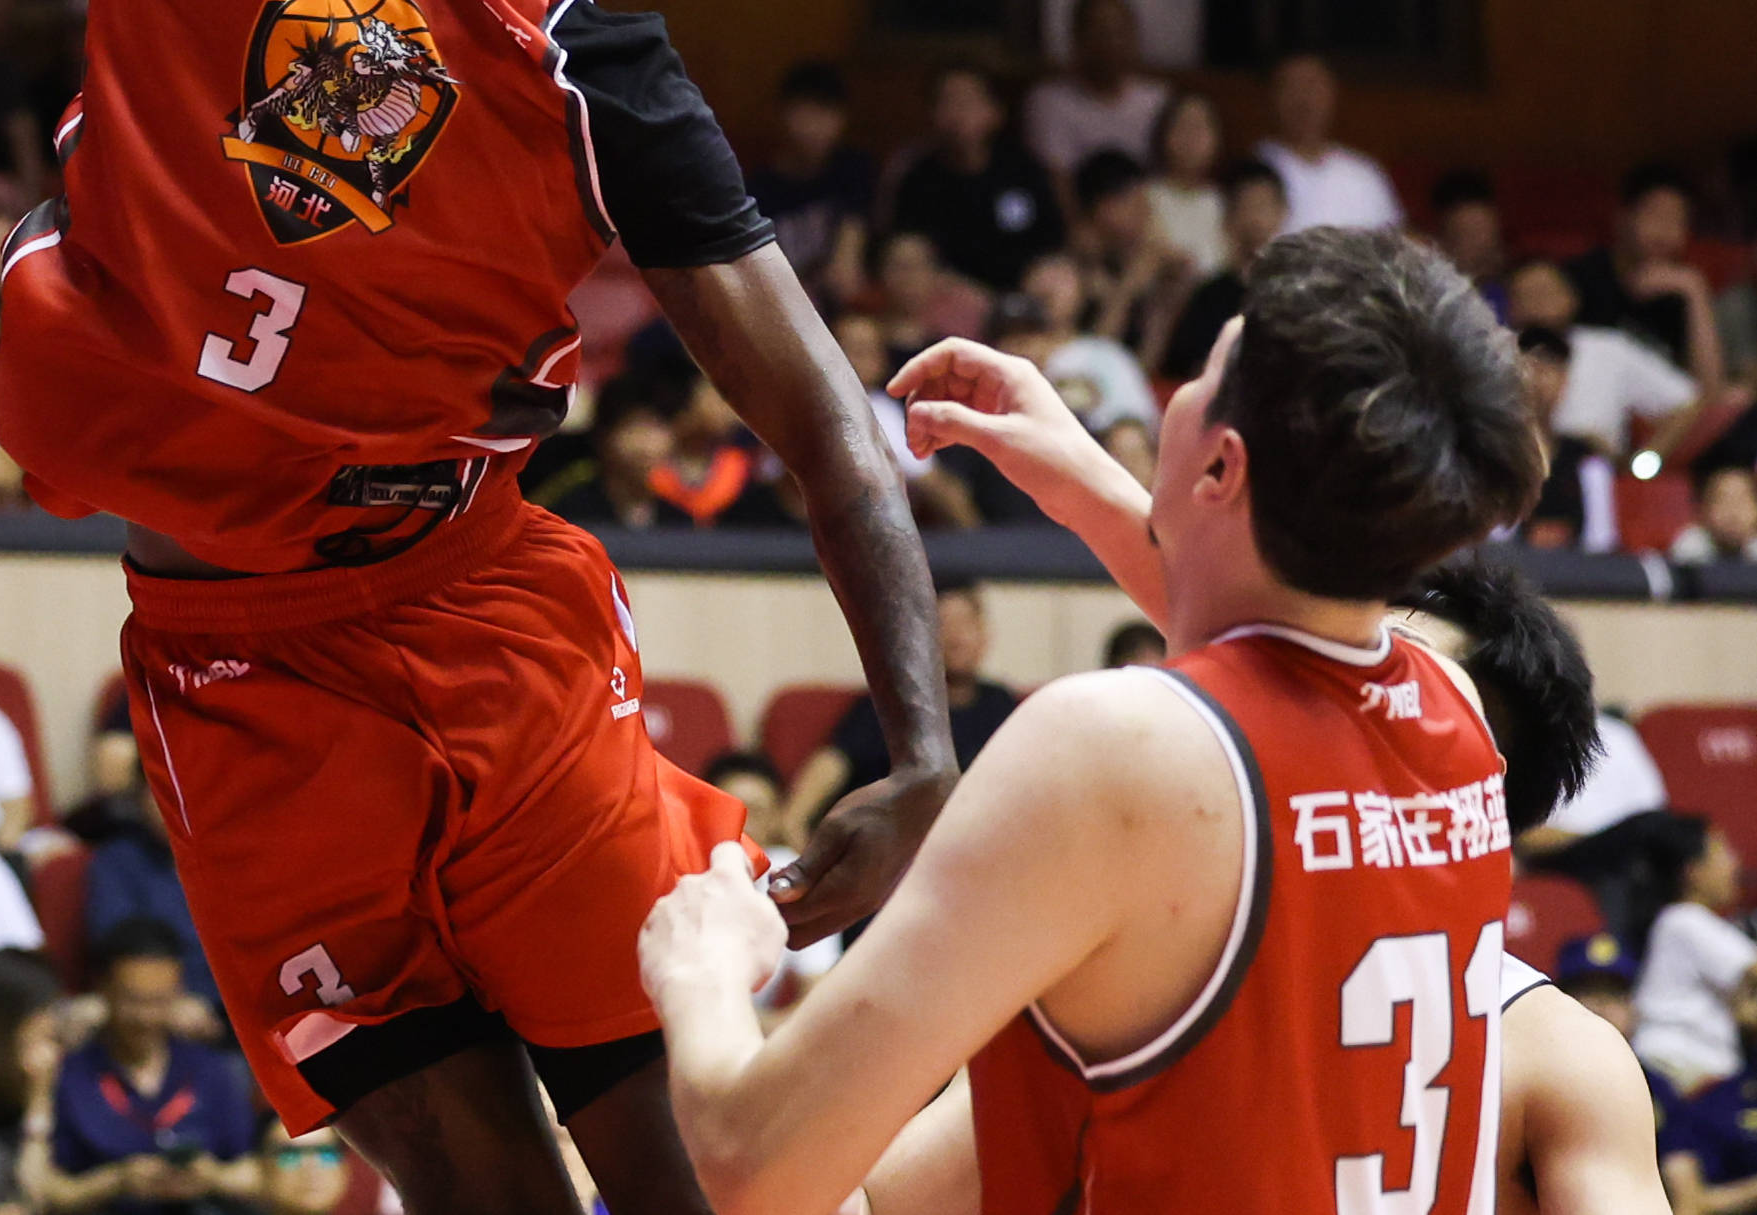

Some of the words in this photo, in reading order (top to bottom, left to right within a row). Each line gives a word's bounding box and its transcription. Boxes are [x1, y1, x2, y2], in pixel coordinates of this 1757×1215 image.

[263, 175, 333, 229] 河北
[197, 267, 306, 393] 3
[1334, 918, 1505, 1215] 31
